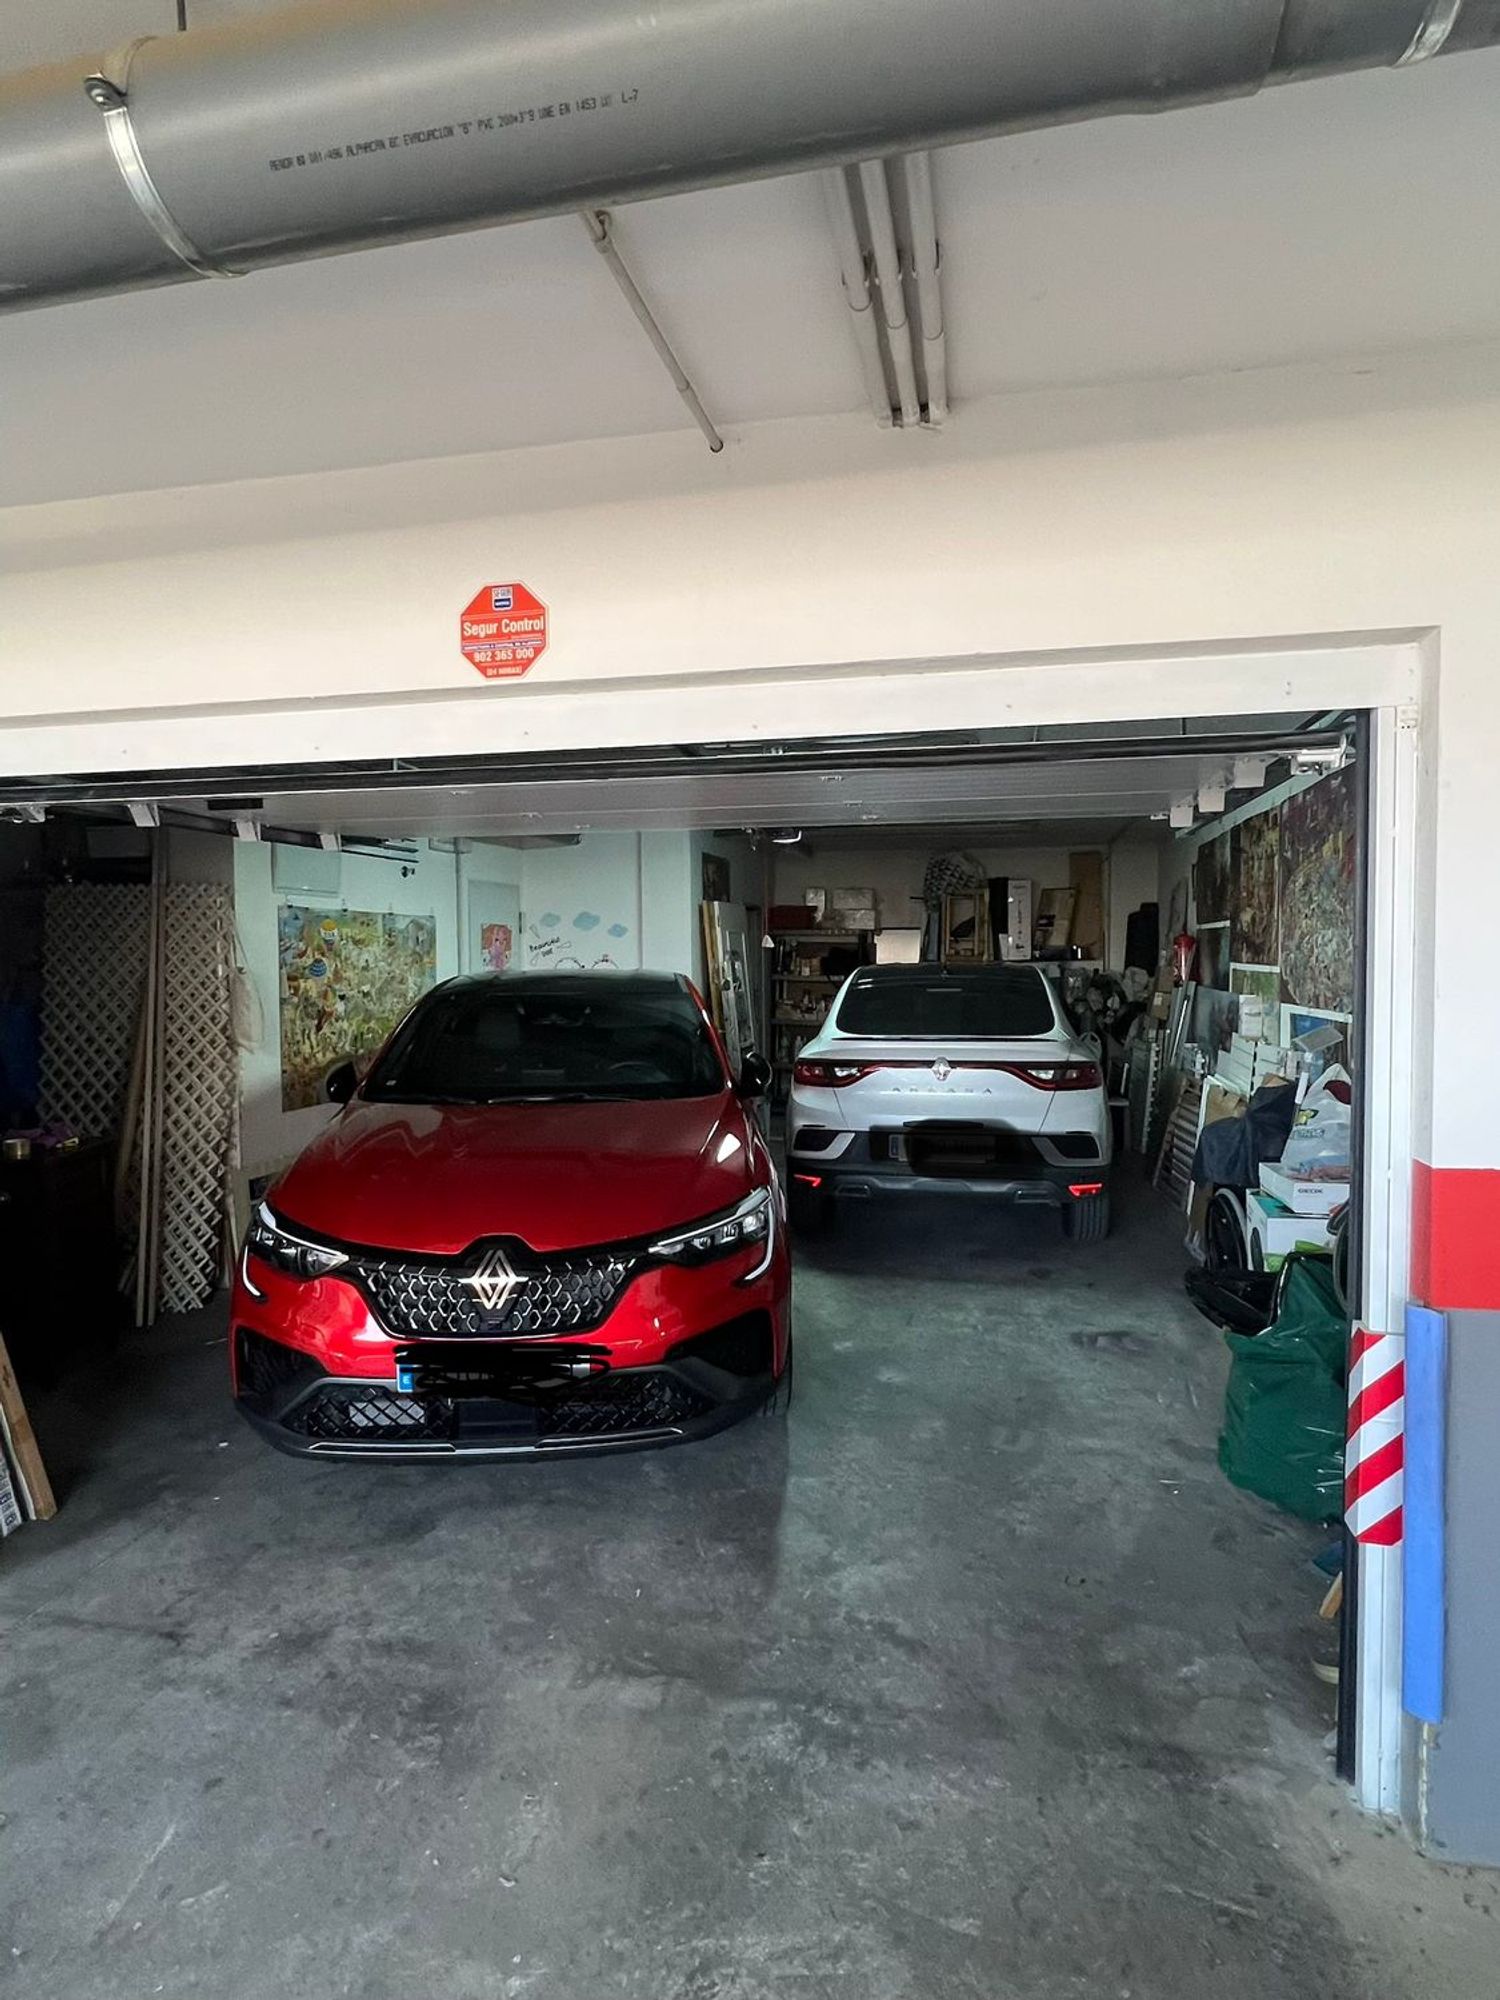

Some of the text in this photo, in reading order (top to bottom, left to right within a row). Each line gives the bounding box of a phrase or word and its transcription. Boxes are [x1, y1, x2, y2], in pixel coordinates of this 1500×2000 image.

[559, 102, 571, 115] EN
[463, 616, 544, 637] Segur Control
[473, 648, 534, 662] 902 365 000
